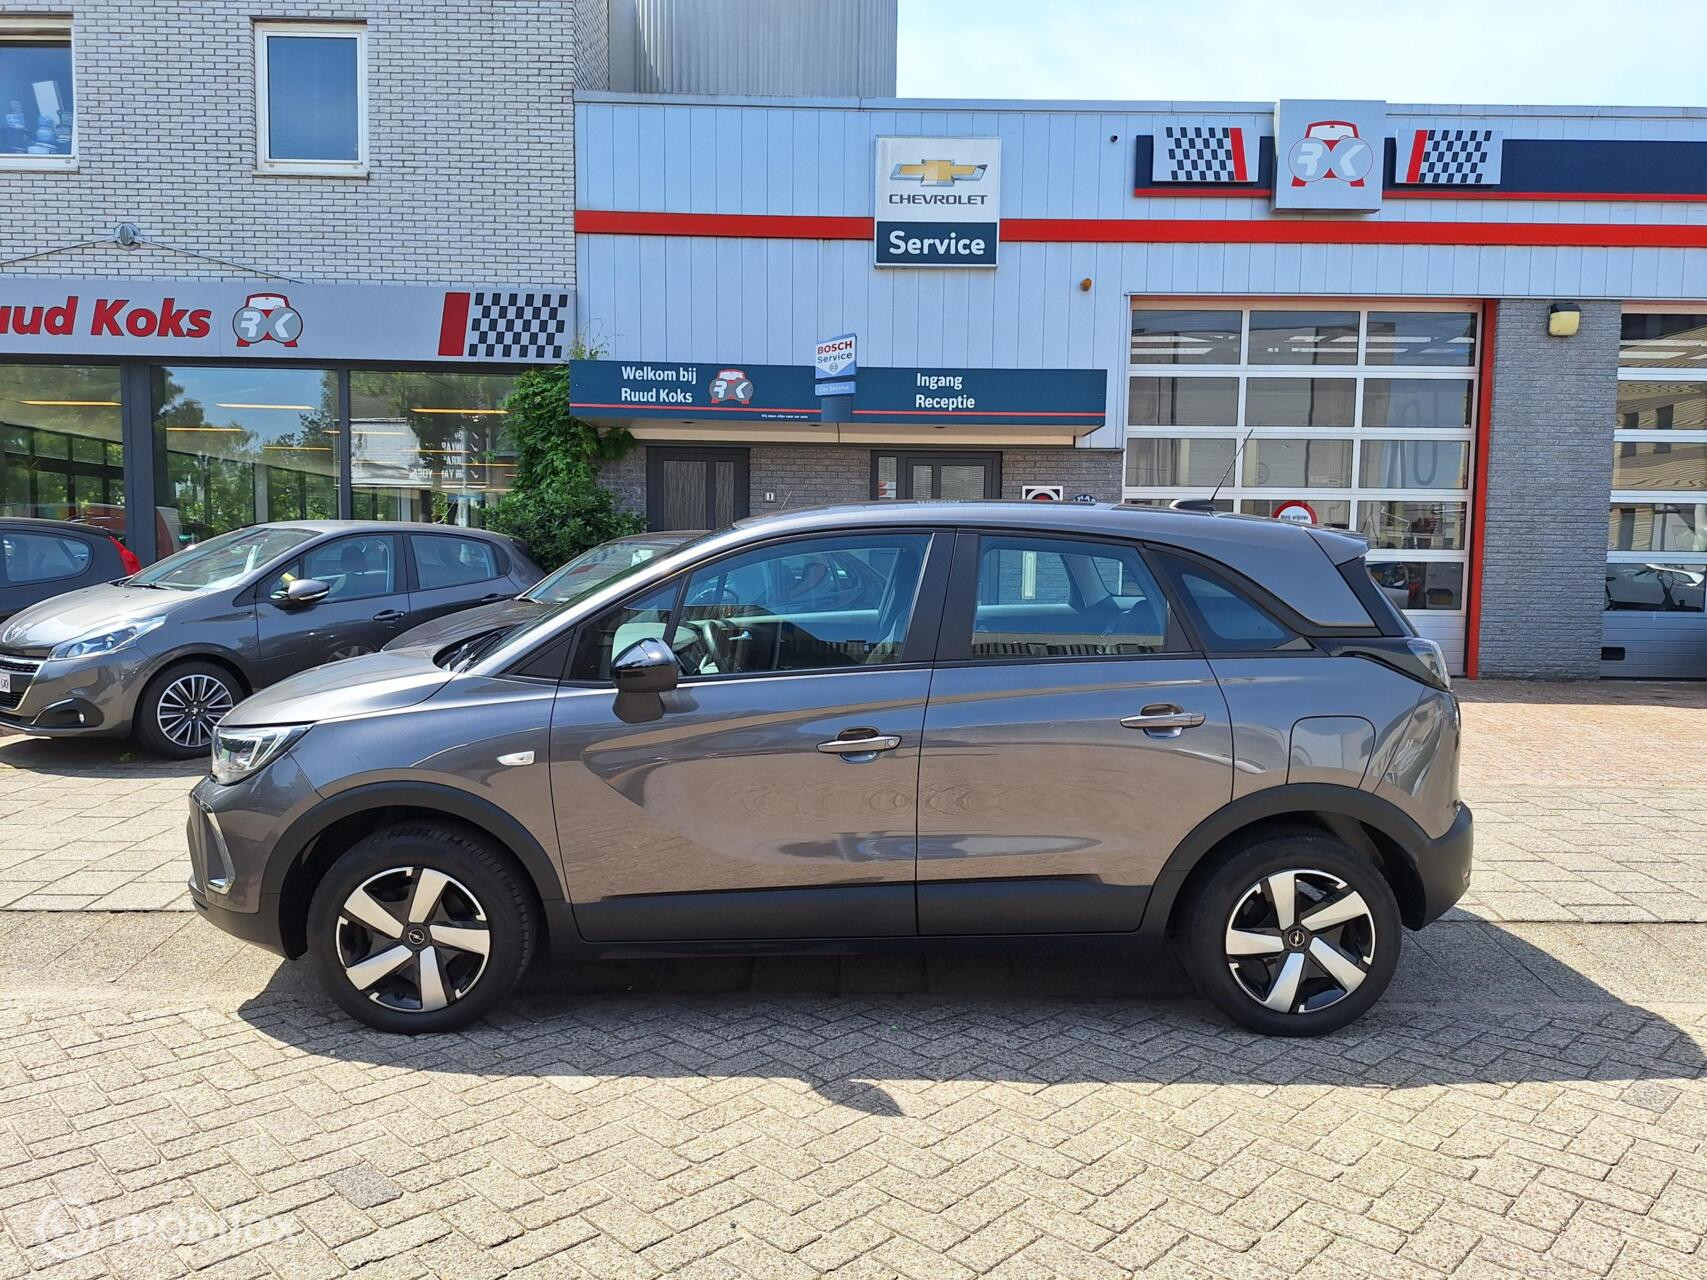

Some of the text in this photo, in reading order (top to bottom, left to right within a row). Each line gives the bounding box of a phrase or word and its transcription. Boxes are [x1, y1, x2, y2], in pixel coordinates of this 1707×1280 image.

[889, 194, 988, 205] CHEVROLET
[889, 230, 986, 255] Service
[90, 298, 212, 338] Koks
[817, 340, 853, 354] BOSCH
[817, 352, 853, 364] Service
[621, 366, 697, 385] Welkom bij
[916, 373, 963, 390] Ingang
[621, 388, 693, 403] Ruud Koks
[915, 394, 976, 411] Receptie
